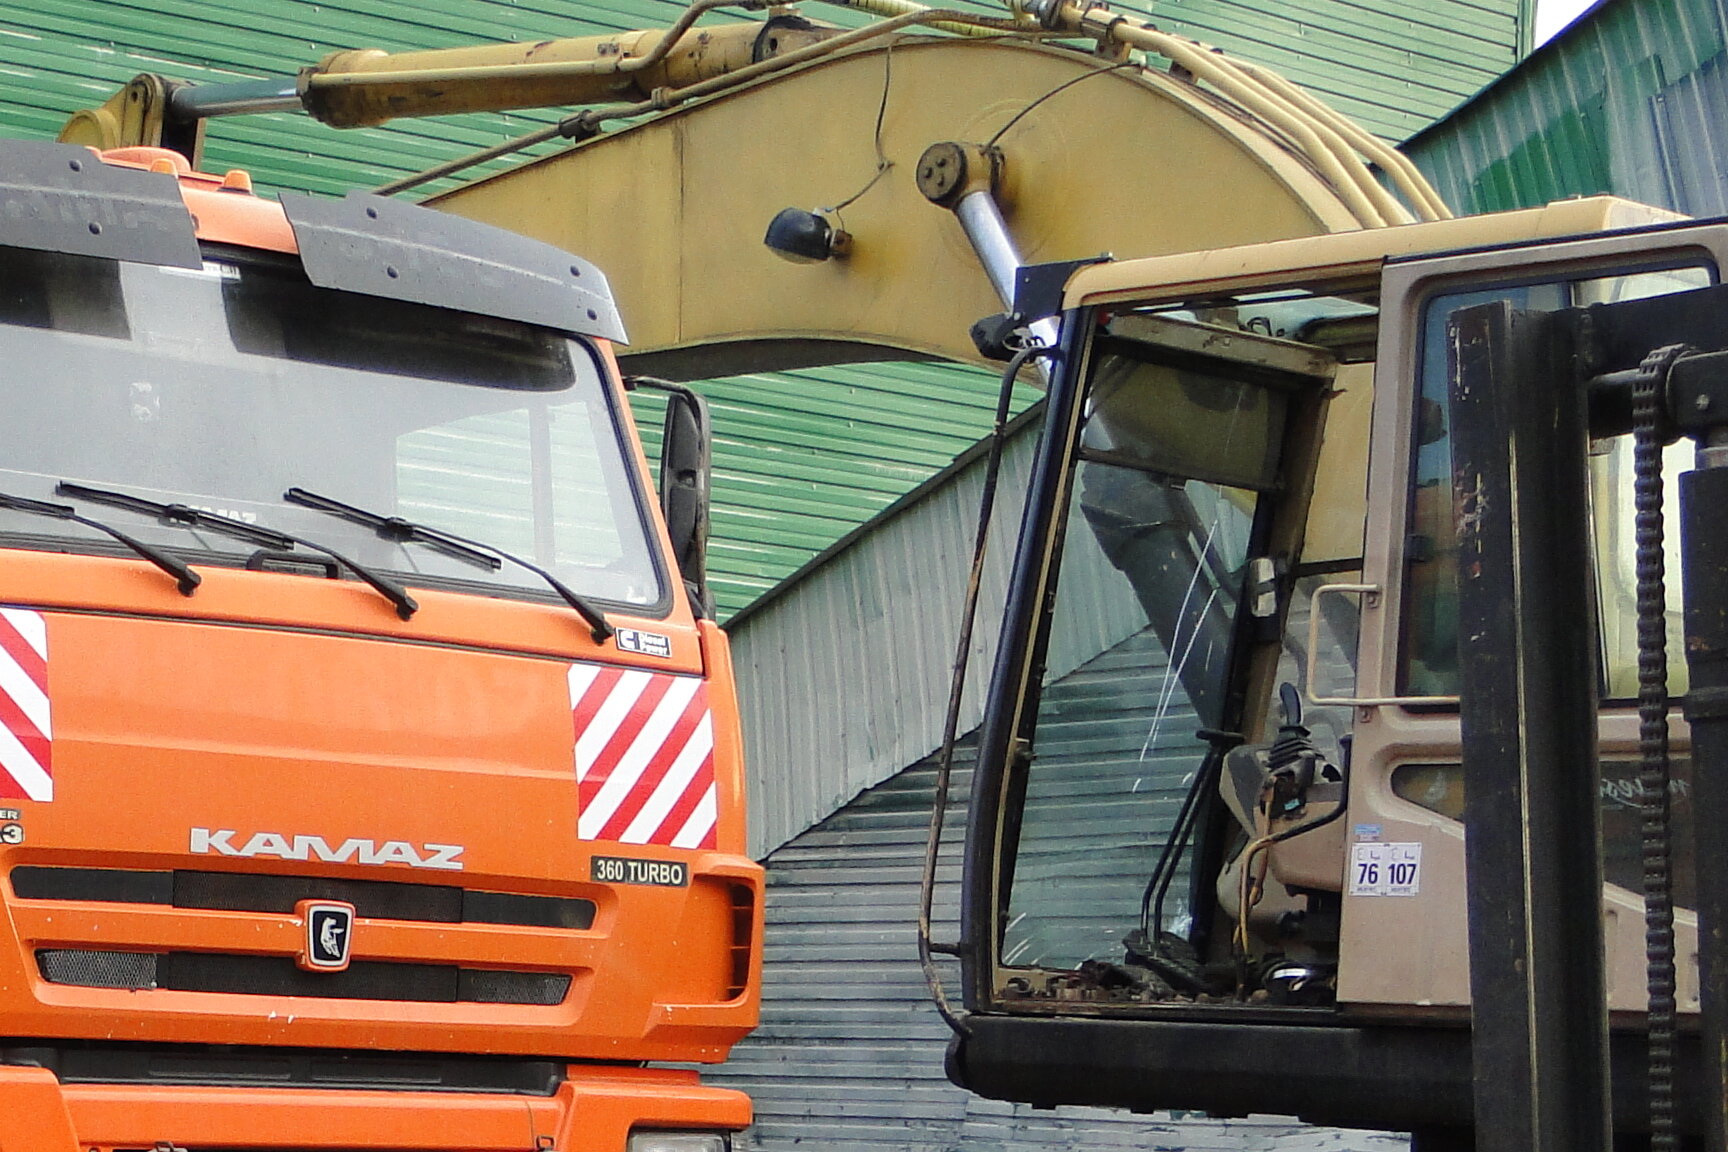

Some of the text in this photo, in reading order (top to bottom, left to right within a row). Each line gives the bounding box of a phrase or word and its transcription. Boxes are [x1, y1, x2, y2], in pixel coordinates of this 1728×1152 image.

[190, 827, 464, 870] KAMAZ
[596, 859, 683, 884] 360 TURBO
[1357, 863, 1379, 885] 76
[1387, 863, 1417, 885] 107
